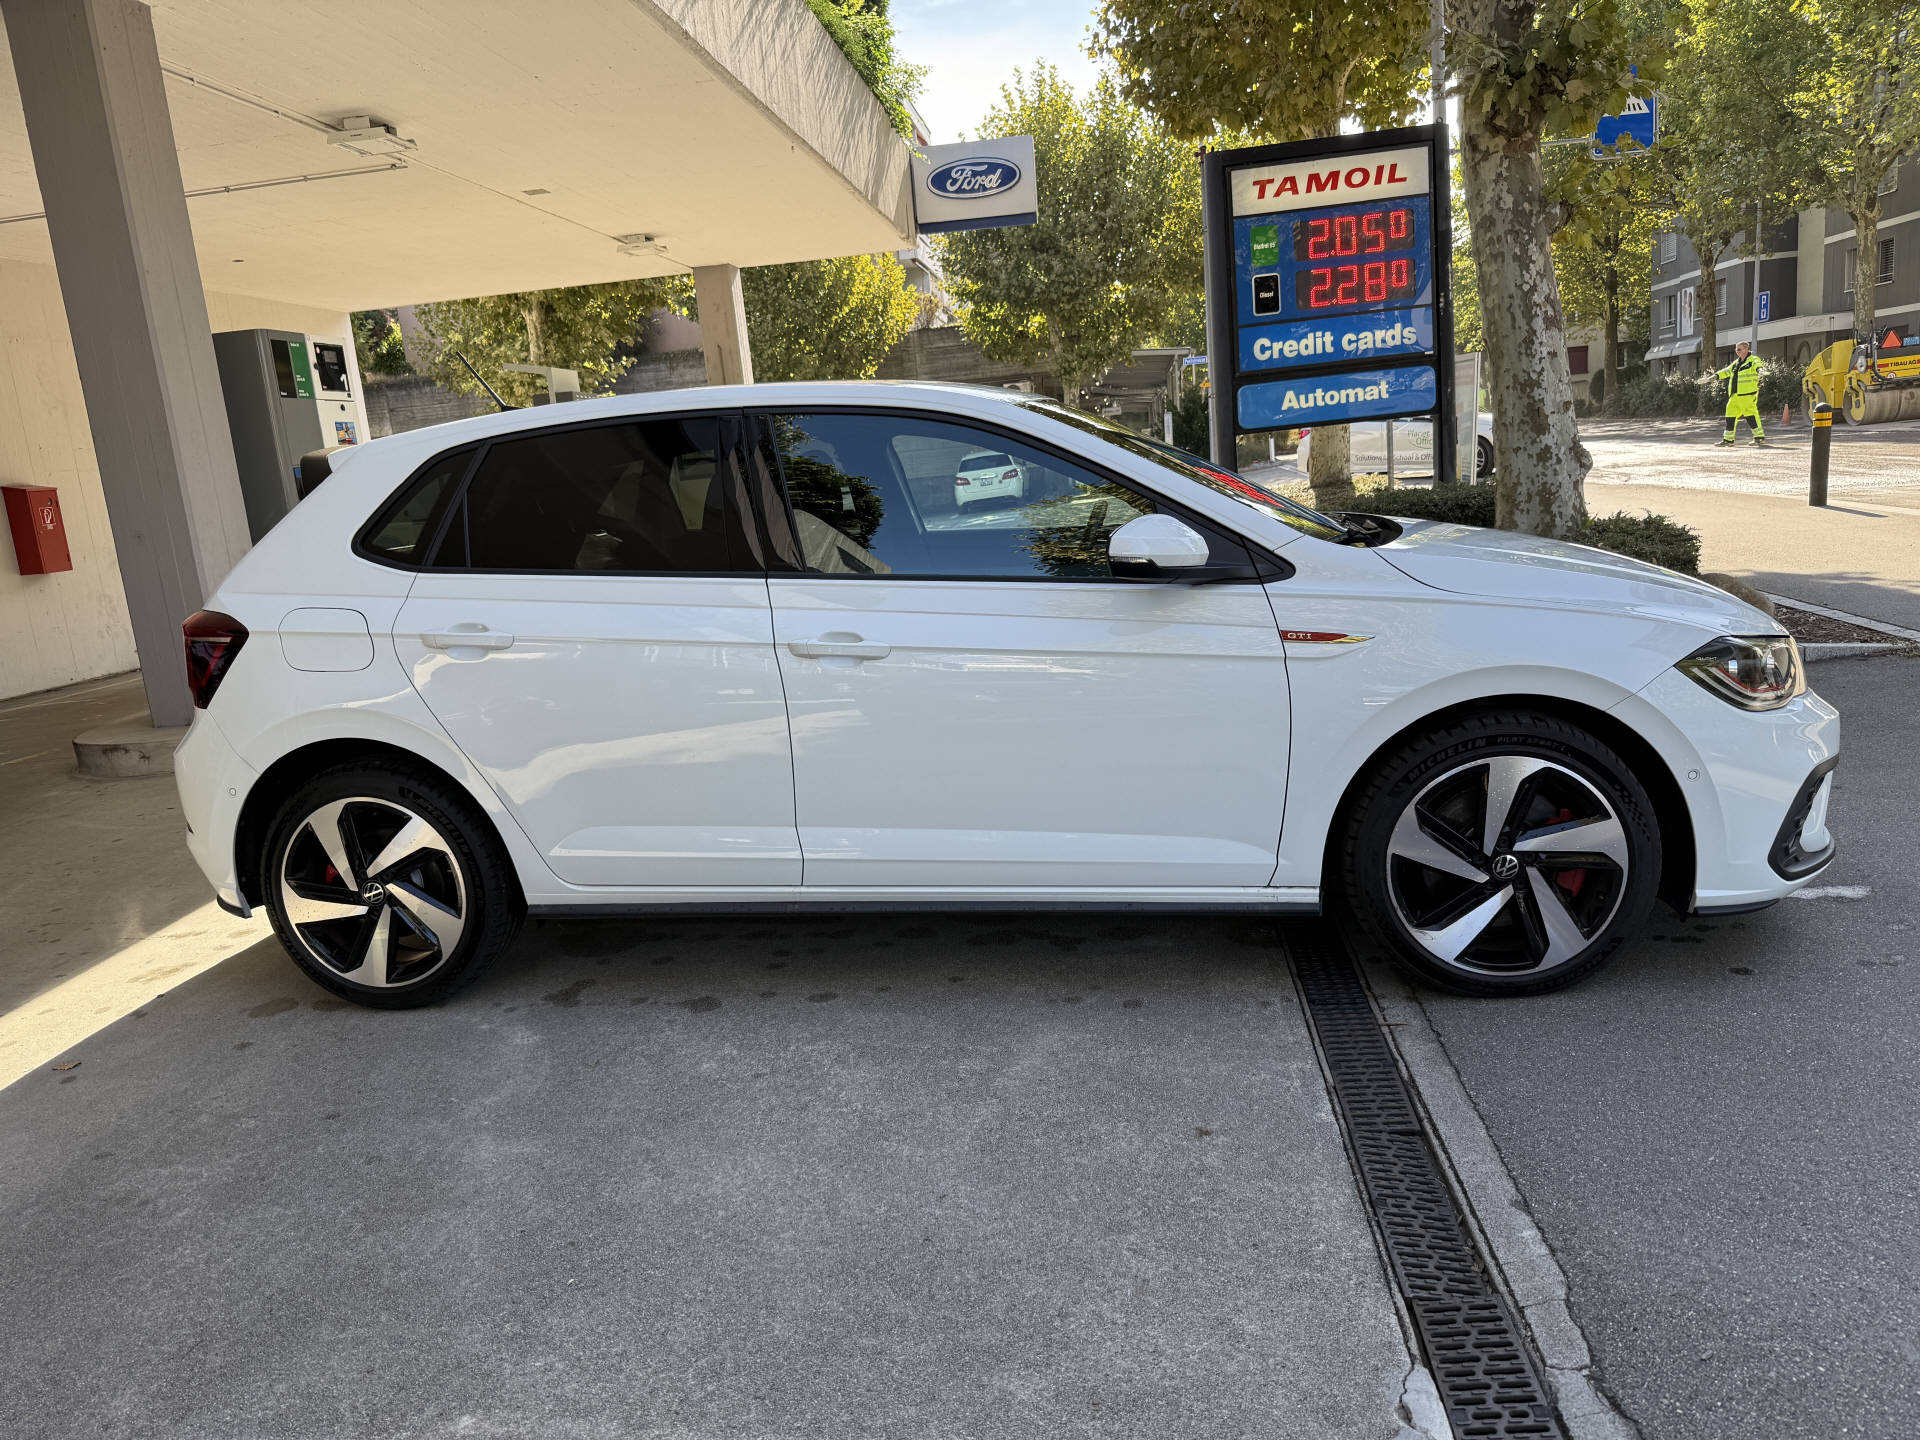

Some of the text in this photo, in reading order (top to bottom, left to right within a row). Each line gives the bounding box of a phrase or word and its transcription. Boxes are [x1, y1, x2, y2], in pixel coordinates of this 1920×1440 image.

[945, 164, 1003, 192] Ford
[1252, 163, 1408, 200] TAMOIL
[1761, 295, 1767, 309] P
[1253, 322, 1417, 361] Credit cards
[340, 373, 349, 391] 1
[1281, 380, 1389, 411] Automat
[1287, 632, 1312, 640] GTI
[1407, 737, 1488, 782] MICHELIN
